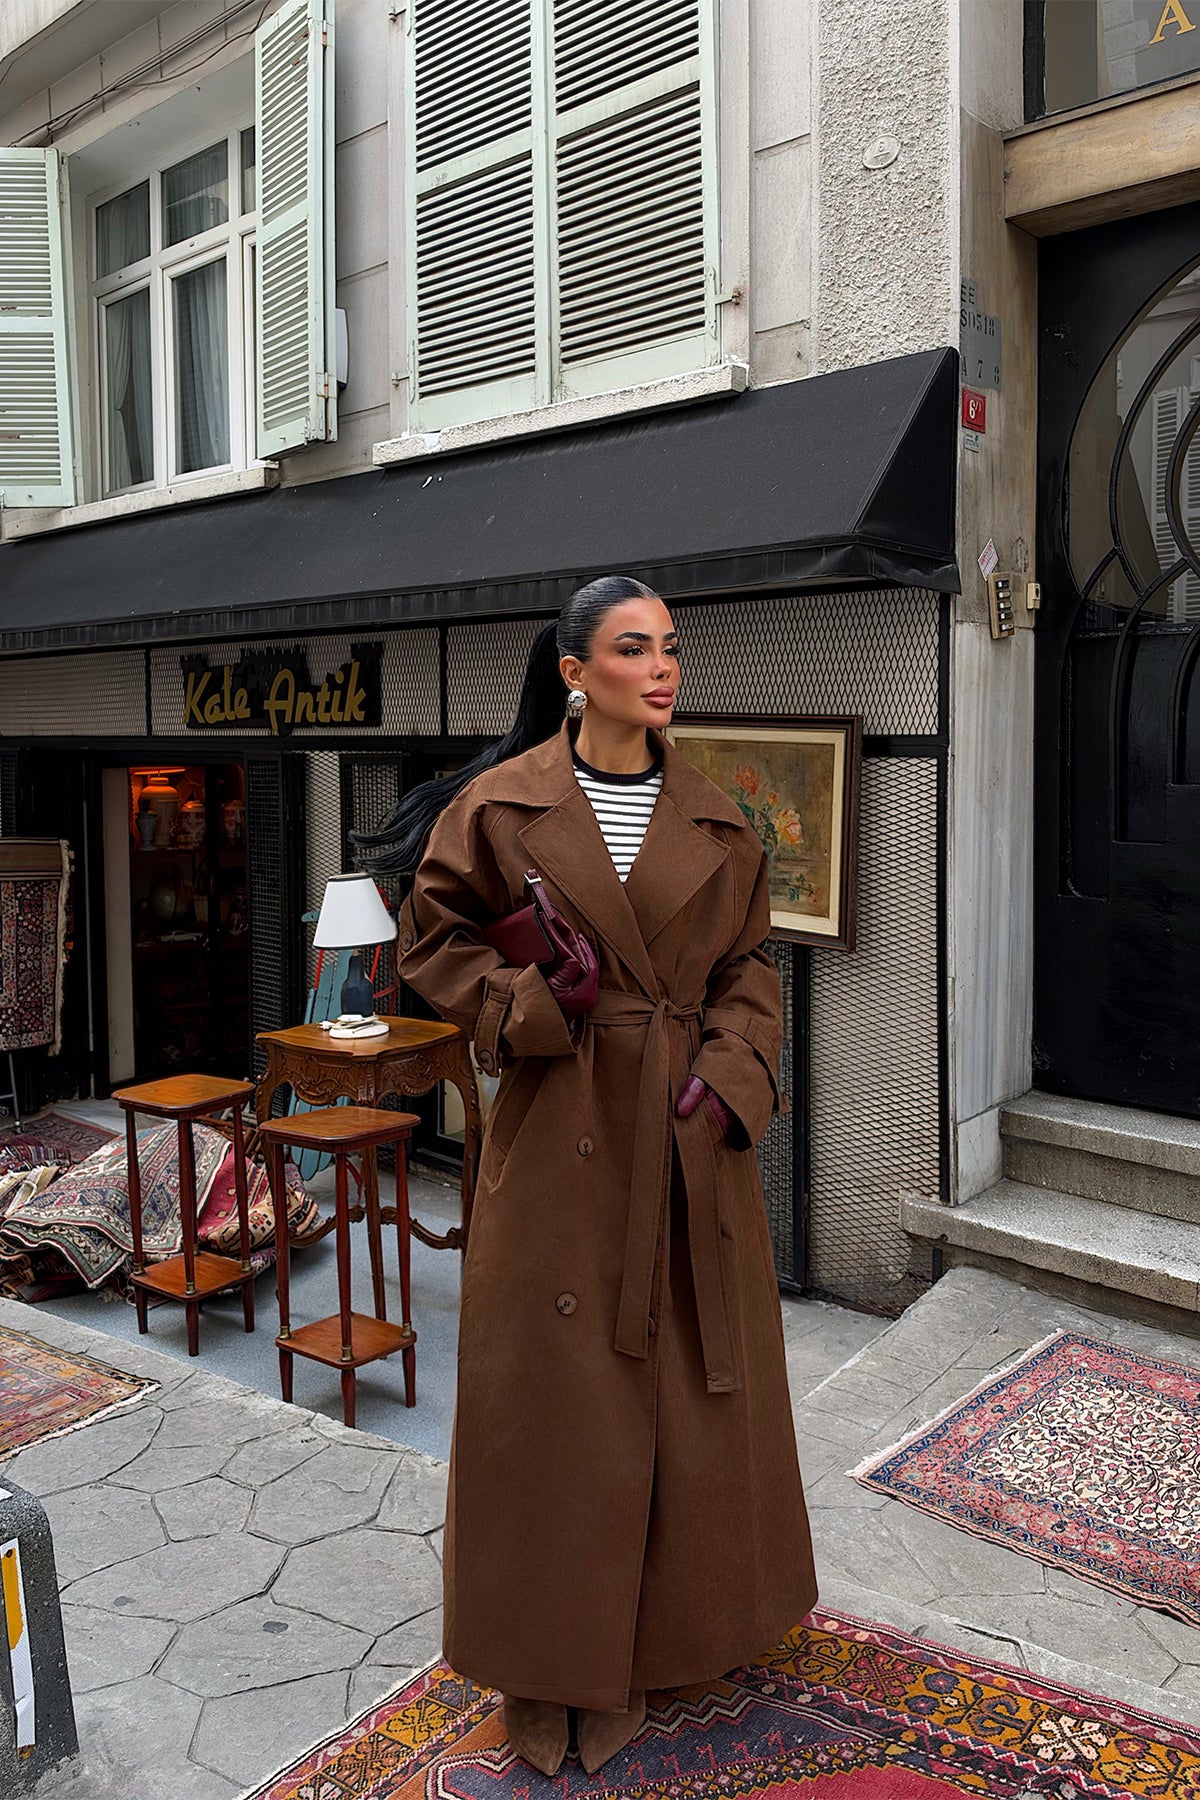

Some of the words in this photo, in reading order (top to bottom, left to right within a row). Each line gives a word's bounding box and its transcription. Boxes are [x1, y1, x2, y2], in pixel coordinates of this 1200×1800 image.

[1149, 0, 1197, 45] A
[183, 664, 251, 725] Kale
[263, 660, 367, 732] Antik
